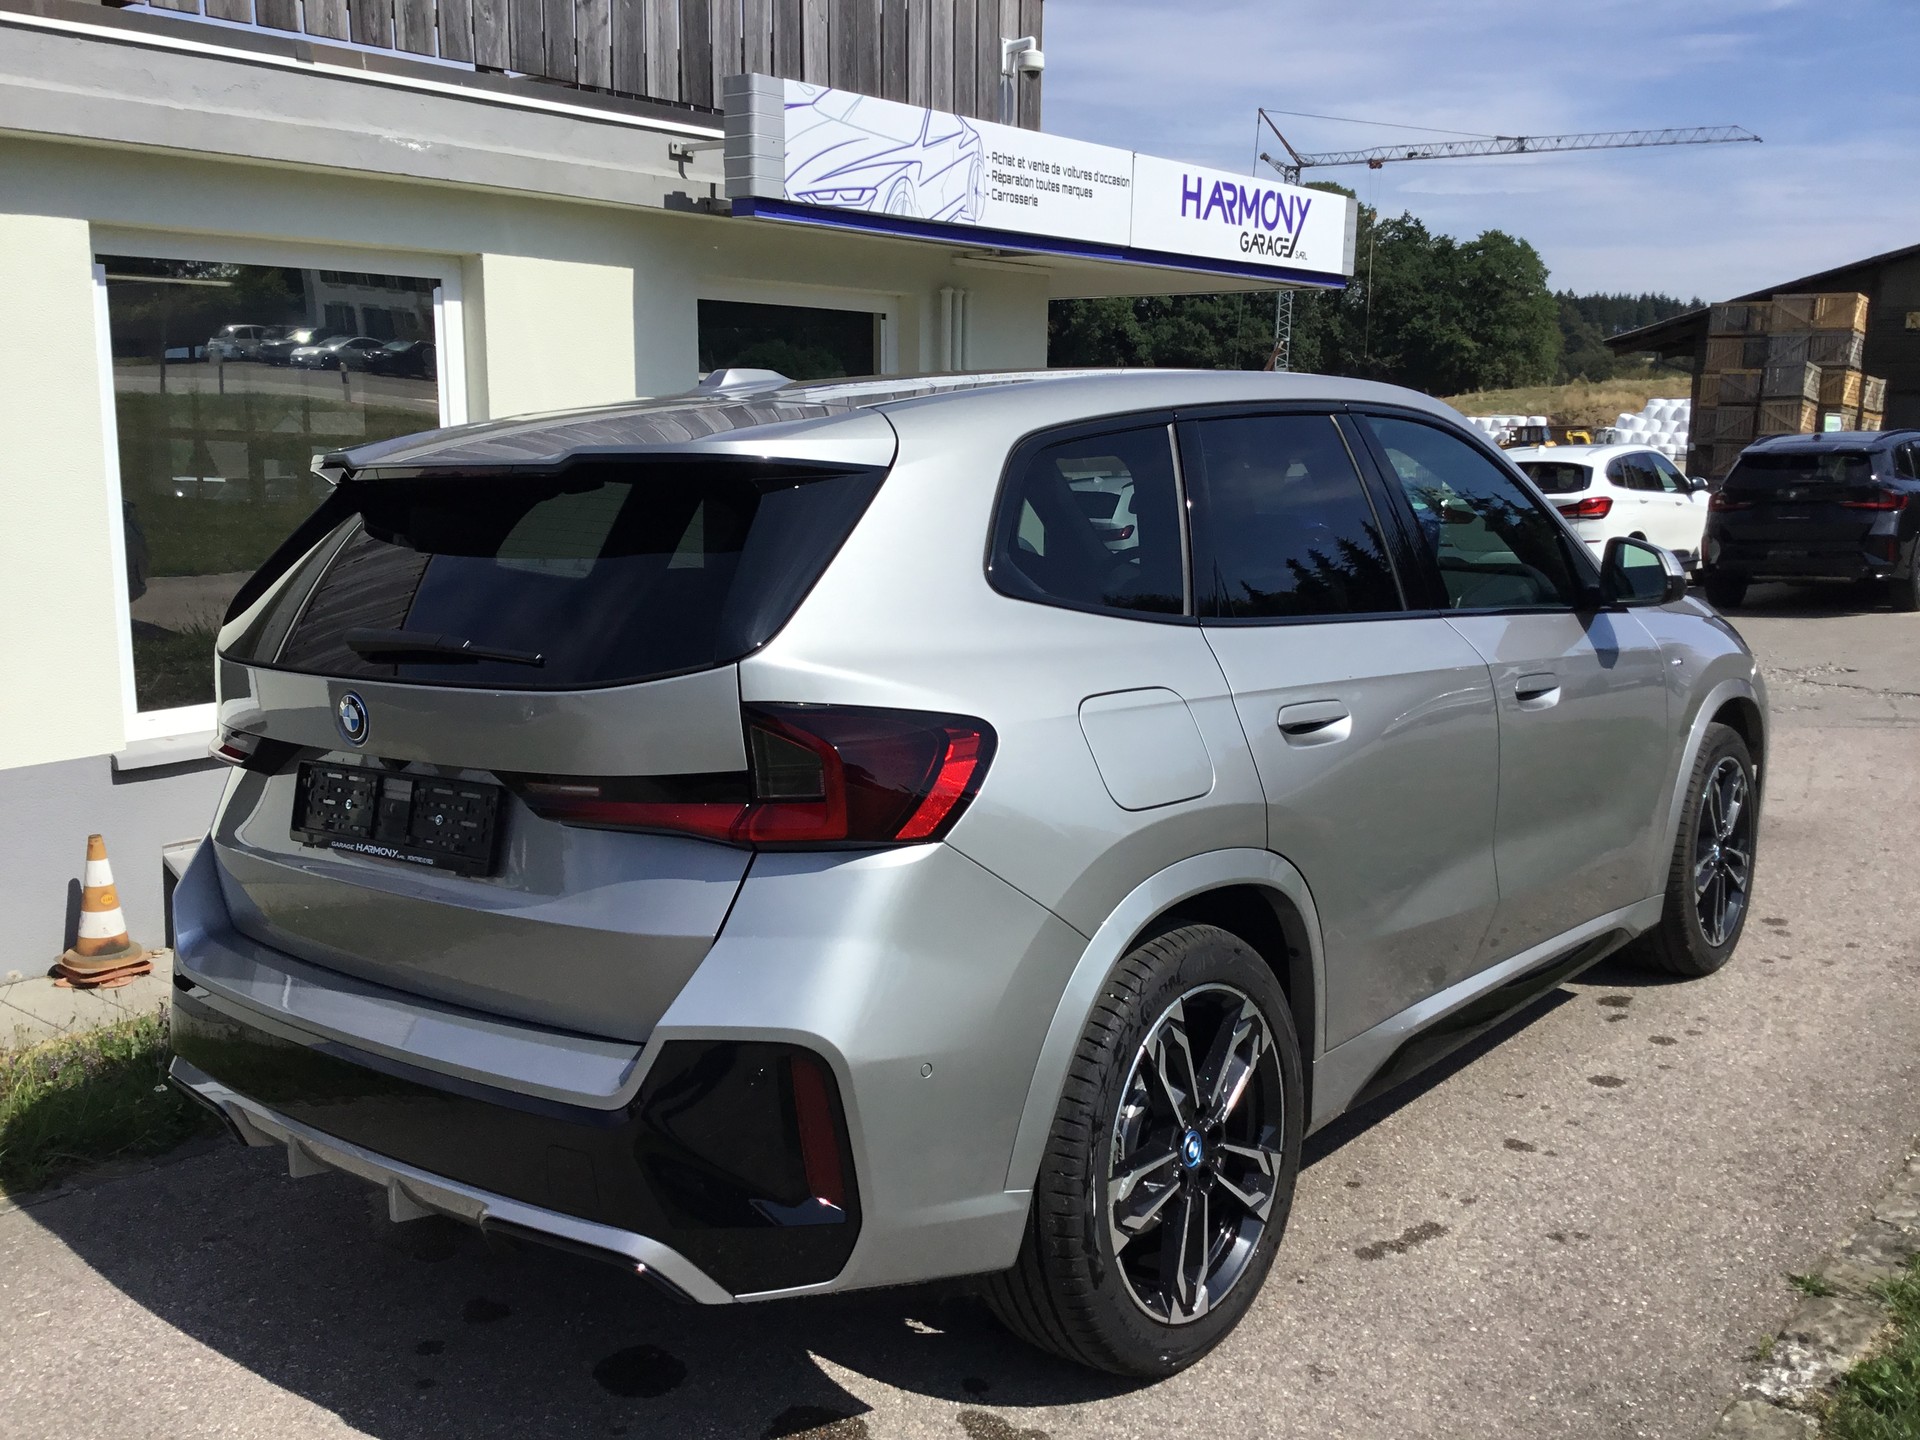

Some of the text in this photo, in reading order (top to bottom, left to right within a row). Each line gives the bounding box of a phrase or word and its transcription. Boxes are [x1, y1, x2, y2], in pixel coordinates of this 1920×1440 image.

[992, 152, 1130, 187] Achat et vente de voitures d'occasion
[992, 169, 1093, 200] Réparation toutes marques
[992, 188, 1038, 207] Carrosserie
[1181, 174, 1312, 256] HARMONY
[1240, 231, 1292, 258] GARAGE
[331, 841, 354, 850] GARAGE
[355, 843, 398, 857] HARMONY
